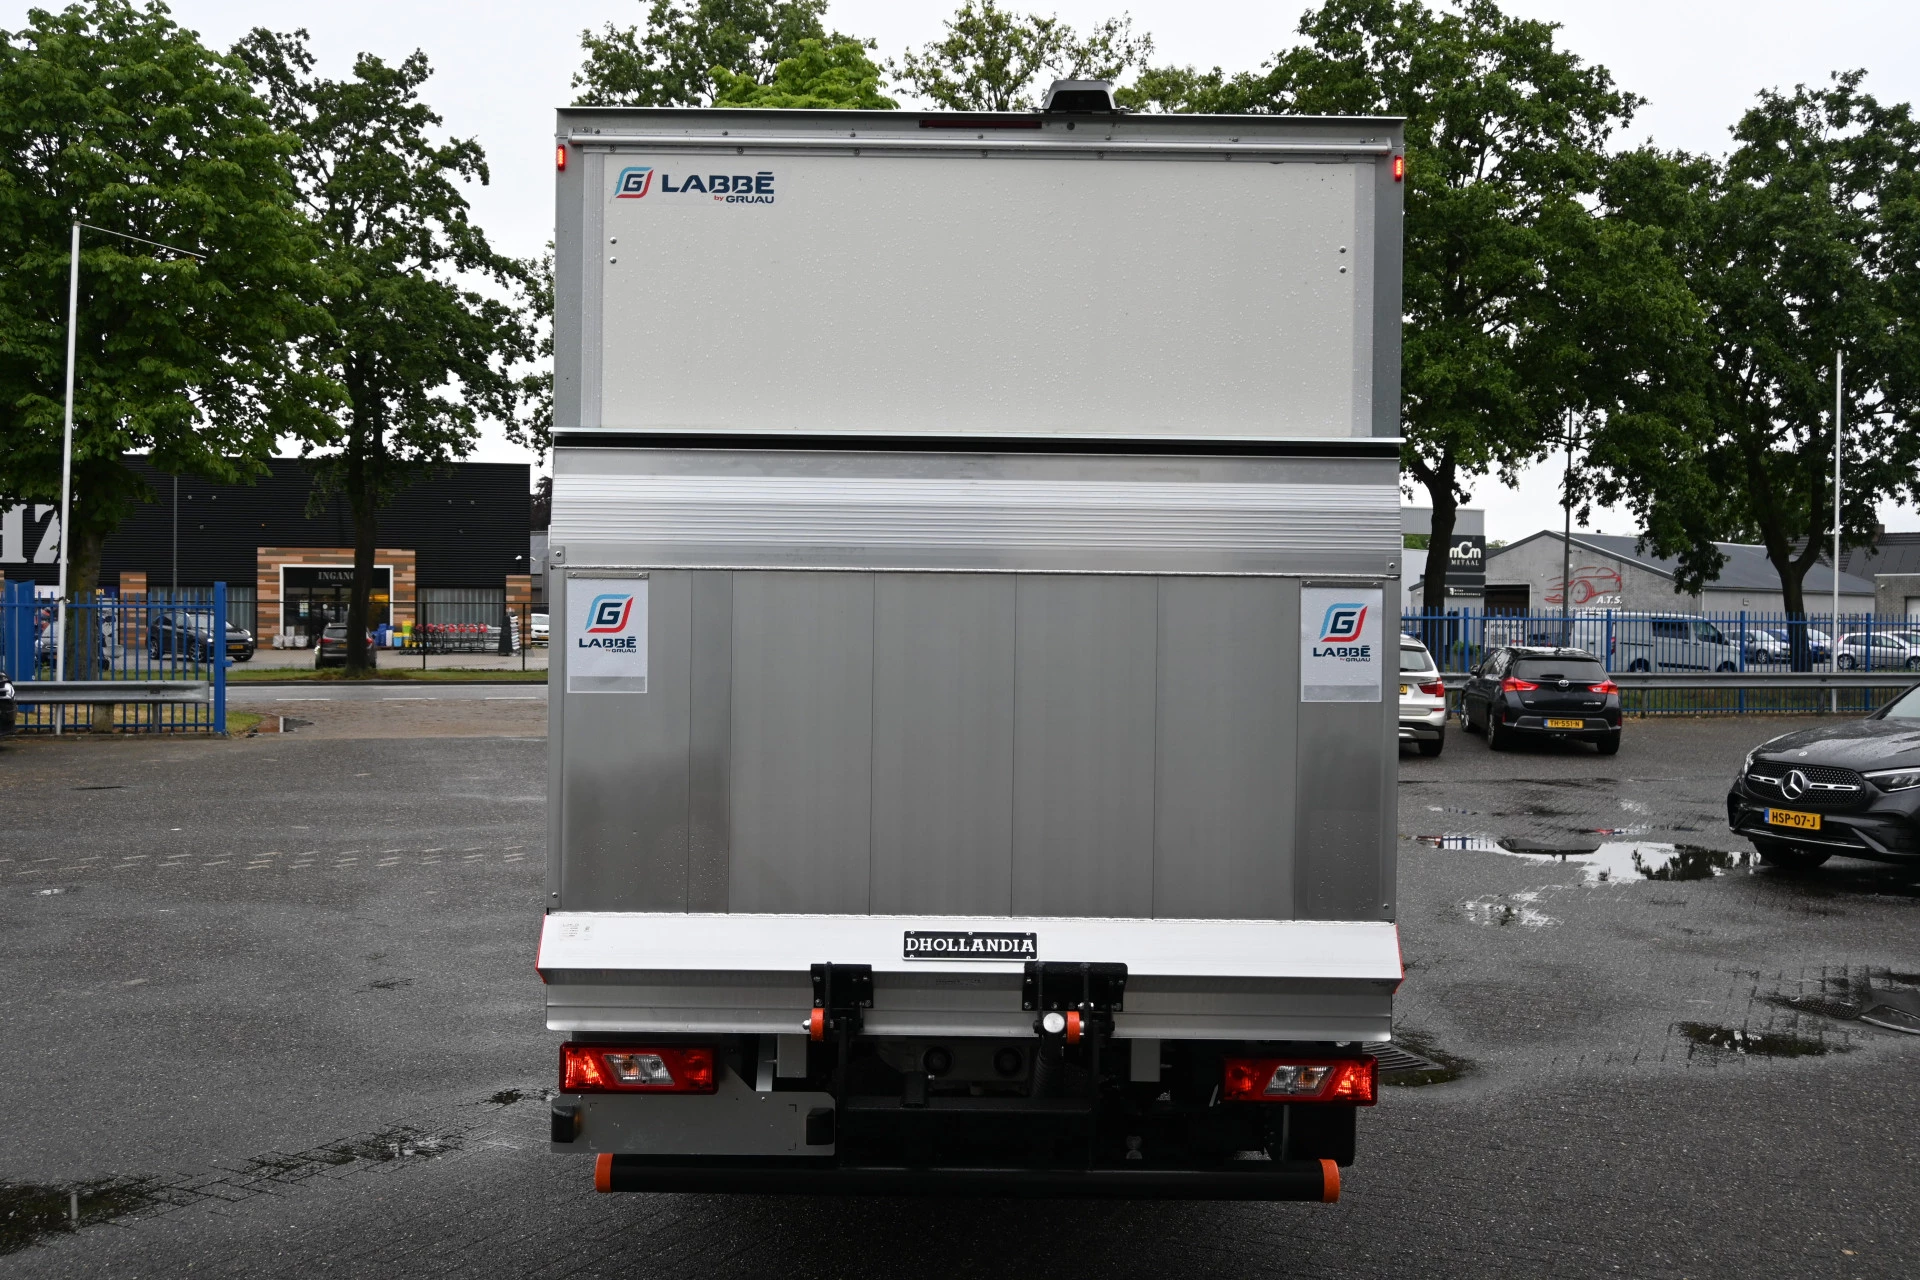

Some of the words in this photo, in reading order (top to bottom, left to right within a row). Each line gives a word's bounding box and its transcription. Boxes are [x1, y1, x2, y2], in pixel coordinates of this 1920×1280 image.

[726, 195, 775, 203] GRUAU
[1596, 596, 1622, 604] A.T.S.
[1772, 811, 1816, 827] HSP-07-J
[905, 938, 1035, 952] DHOLLANDIA
